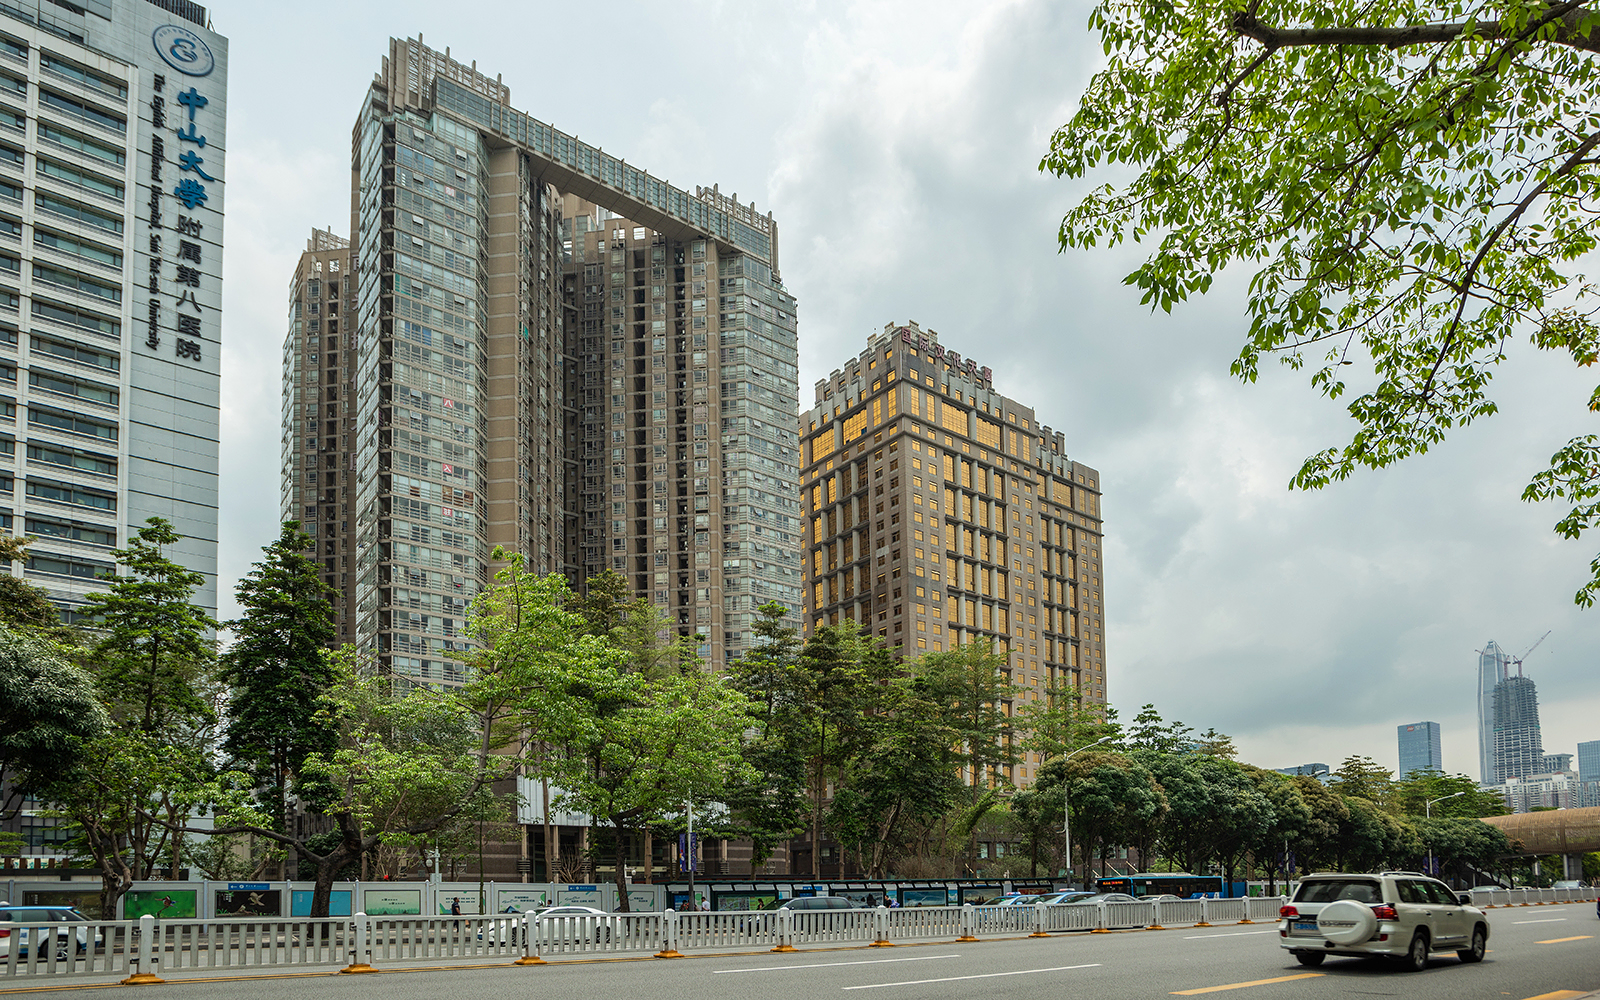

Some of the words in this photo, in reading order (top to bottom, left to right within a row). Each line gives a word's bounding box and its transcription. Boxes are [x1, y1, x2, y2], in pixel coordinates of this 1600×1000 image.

[154, 73, 165, 93] The
[150, 95, 166, 129] Eighth
[151, 133, 164, 183] Affiliated
[150, 233, 162, 254] Sun
[149, 257, 162, 295] Yat-sen
[145, 298, 161, 351] University
